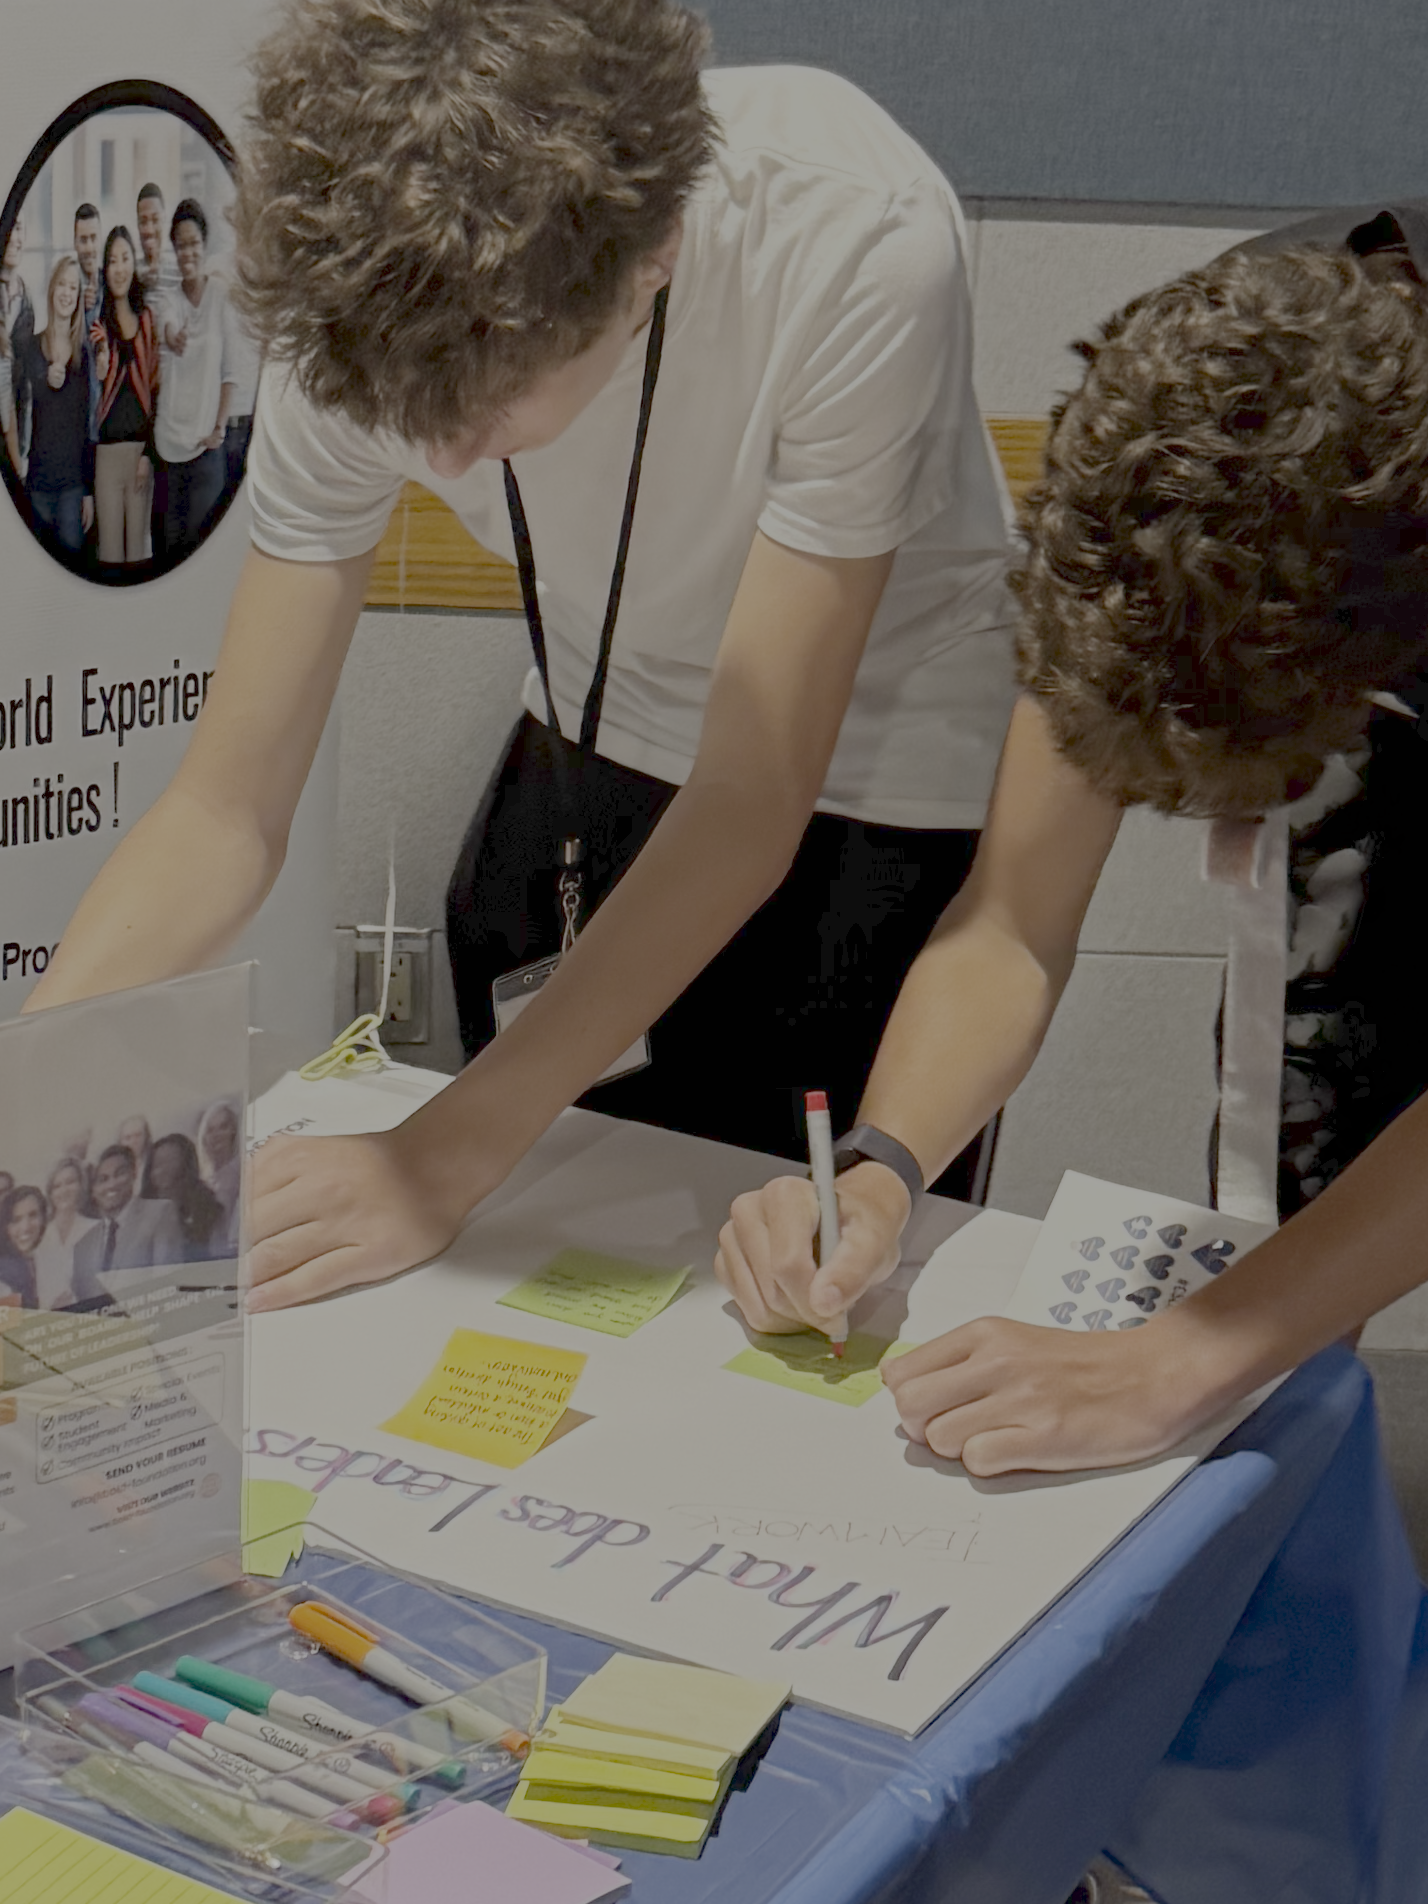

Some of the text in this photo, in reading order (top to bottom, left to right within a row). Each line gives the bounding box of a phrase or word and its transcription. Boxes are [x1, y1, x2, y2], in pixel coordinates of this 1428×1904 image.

[58, 1418, 100, 1441] Student
[104, 1461, 133, 1481] SEND
[135, 1451, 163, 1470] YOUR
[501, 1492, 653, 1572] does
[670, 1512, 991, 1566] TEAMWORK
[650, 1533, 952, 1683] What
[258, 1726, 310, 1760] Sharpie
[301, 1713, 355, 1744] Sharpie
